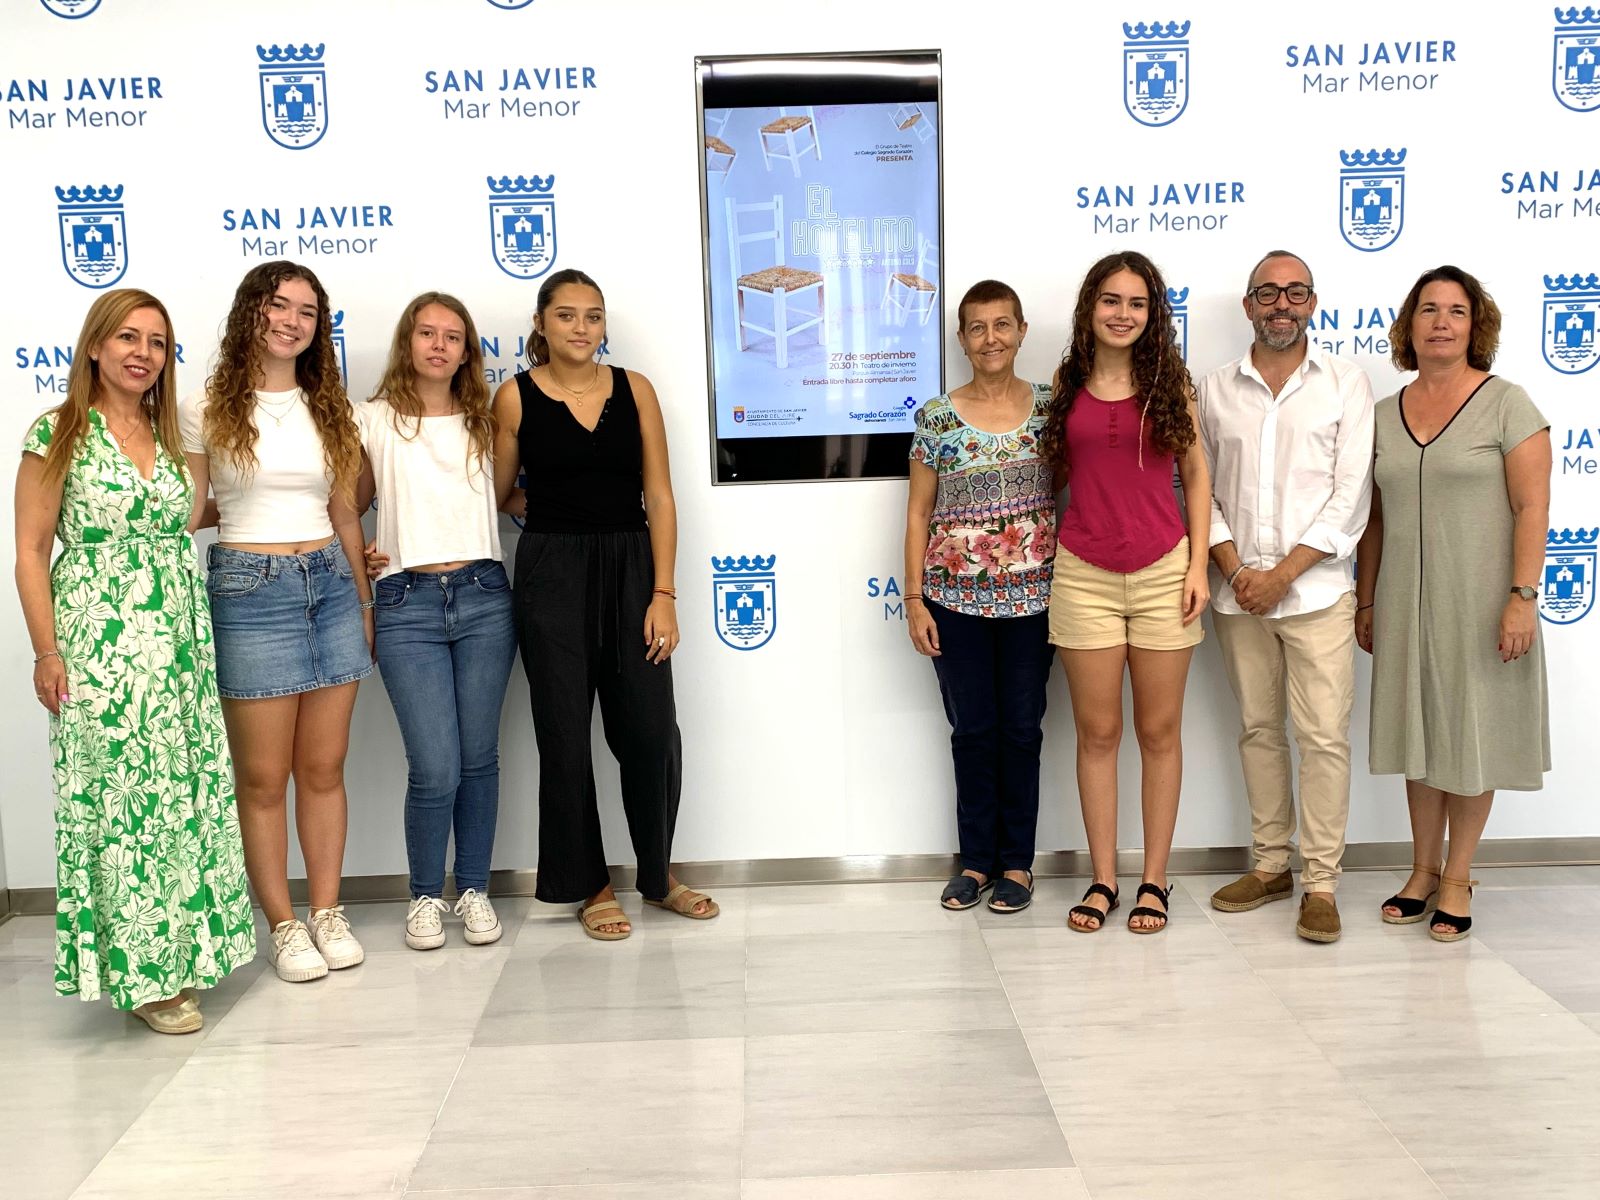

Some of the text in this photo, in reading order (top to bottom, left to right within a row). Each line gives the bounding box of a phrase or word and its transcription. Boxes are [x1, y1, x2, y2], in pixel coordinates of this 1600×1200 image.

[1286, 41, 1456, 67] SAN JAVIER
[0, 77, 163, 102] AN JAVIER
[426, 67, 597, 93] SAN JAVIER
[1304, 71, 1438, 93] Mar Menor
[9, 107, 147, 129] Mar Menor
[445, 98, 580, 119] Mar Menor
[1501, 172, 1559, 194] SAN
[806, 184, 838, 220] EL
[1077, 182, 1245, 208] SAN JAVIER
[223, 206, 393, 231] SAN JAVIER
[1517, 200, 1564, 219] Mar
[1095, 212, 1228, 234] Mar Menor
[243, 235, 377, 257] Mar Menor
[792, 217, 914, 256] HOTELITO
[16, 345, 73, 369] SAN
[829, 362, 851, 370] 20.30
[832, 350, 916, 362] 27 de septiembre
[35, 374, 69, 394] Ma
[485, 367, 507, 384] ar
[829, 377, 845, 385] libre
[864, 376, 898, 384] completar
[899, 375, 917, 383] aforo
[849, 410, 907, 420] Sagrado Corazón
[867, 576, 901, 597] SA
